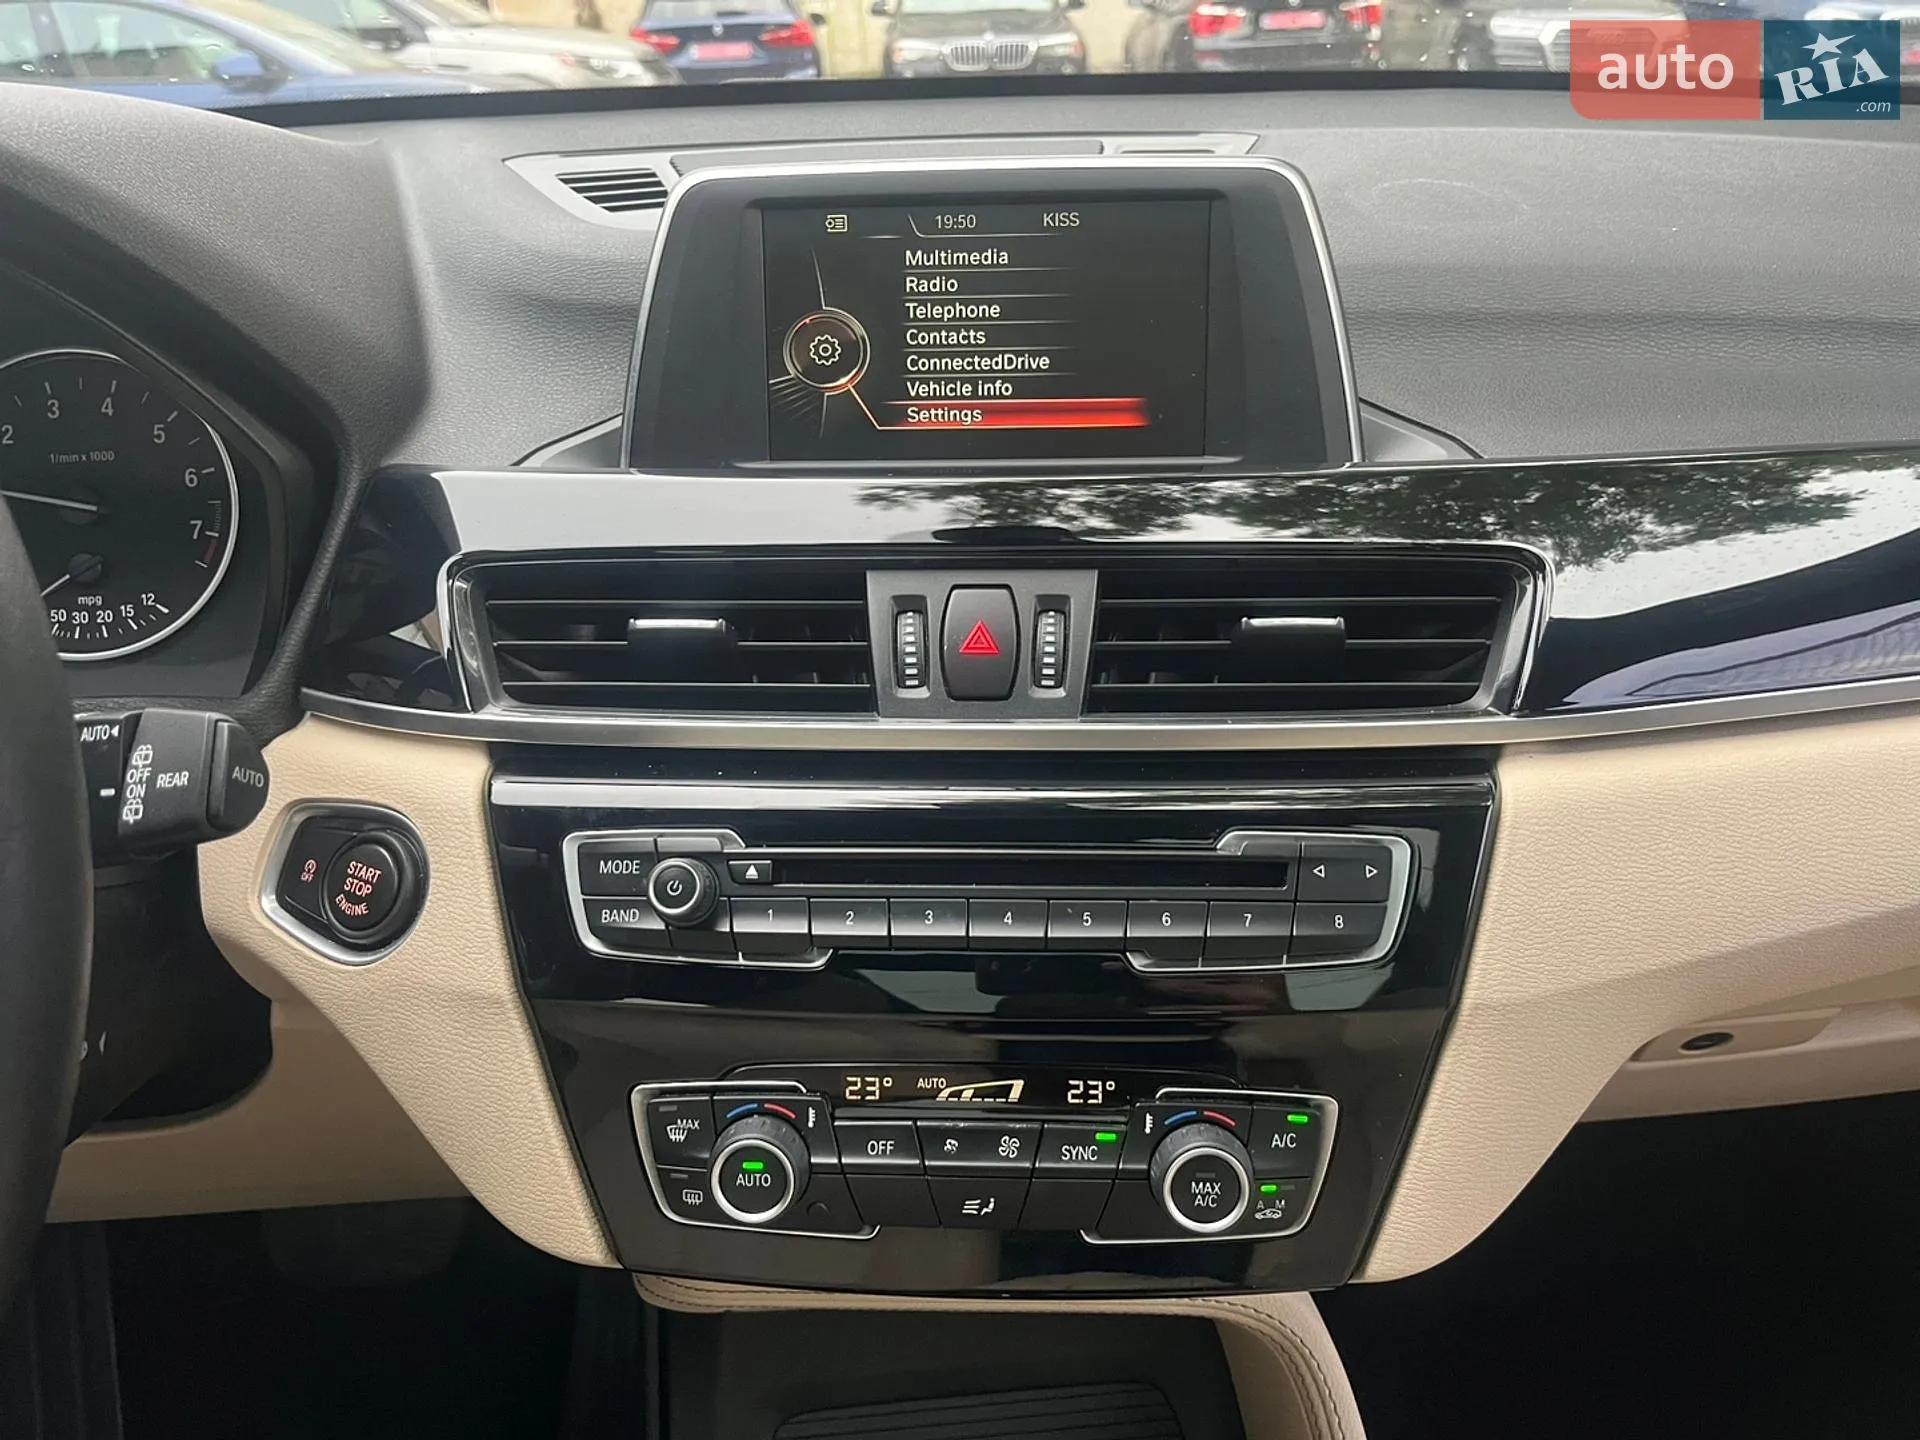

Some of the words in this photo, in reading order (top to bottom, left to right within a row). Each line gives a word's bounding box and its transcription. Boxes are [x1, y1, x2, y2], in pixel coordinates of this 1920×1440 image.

[934, 214, 976, 229] 19:50
[1043, 213, 1080, 227] KISS
[905, 249, 1009, 266] Multimedia
[905, 277, 959, 293] Radio
[905, 302, 1001, 322] Telephone
[906, 328, 987, 345] Contacts
[906, 354, 1050, 371] ConnectedDrive
[906, 381, 972, 397] Vehicle
[978, 381, 1013, 397] info
[47, 400, 60, 419] 3
[101, 397, 115, 416] 4
[907, 407, 983, 425] Settings
[1, 424, 14, 444] 2
[153, 424, 166, 443] 5
[50, 452, 79, 464] 1/min
[90, 450, 115, 462] 1000
[185, 468, 198, 487] 6
[190, 520, 203, 539] 7
[50, 609, 67, 622] 50
[72, 611, 89, 624] 30
[96, 610, 113, 623] 20
[120, 604, 135, 618] 15
[141, 593, 155, 606] 12
[78, 596, 103, 606] mpg
[80, 725, 110, 741] AUTO
[127, 768, 151, 784] OFF
[156, 771, 189, 788] REAR
[232, 766, 265, 788] AUTO
[126, 784, 147, 798] ON
[347, 861, 382, 883] START
[600, 860, 641, 874] MODE
[344, 877, 372, 897] STOP
[335, 893, 369, 916] ENGINE
[601, 908, 640, 923] BAND
[845, 910, 855, 925] 2
[924, 910, 934, 925] 3
[1003, 911, 1013, 925] 4
[1082, 911, 1092, 926] 5
[1161, 912, 1171, 926] 6
[1244, 913, 1253, 928] 7
[1334, 914, 1344, 929] 8
[918, 1078, 947, 1089] AUTO
[677, 1119, 700, 1130] MAX
[867, 1141, 894, 1155] OFF
[1271, 1133, 1297, 1148] A/C
[1061, 1146, 1098, 1161] SYNC
[736, 1173, 771, 1187] AUTO
[1191, 1182, 1221, 1195] MAX
[1194, 1195, 1218, 1208] A/C
